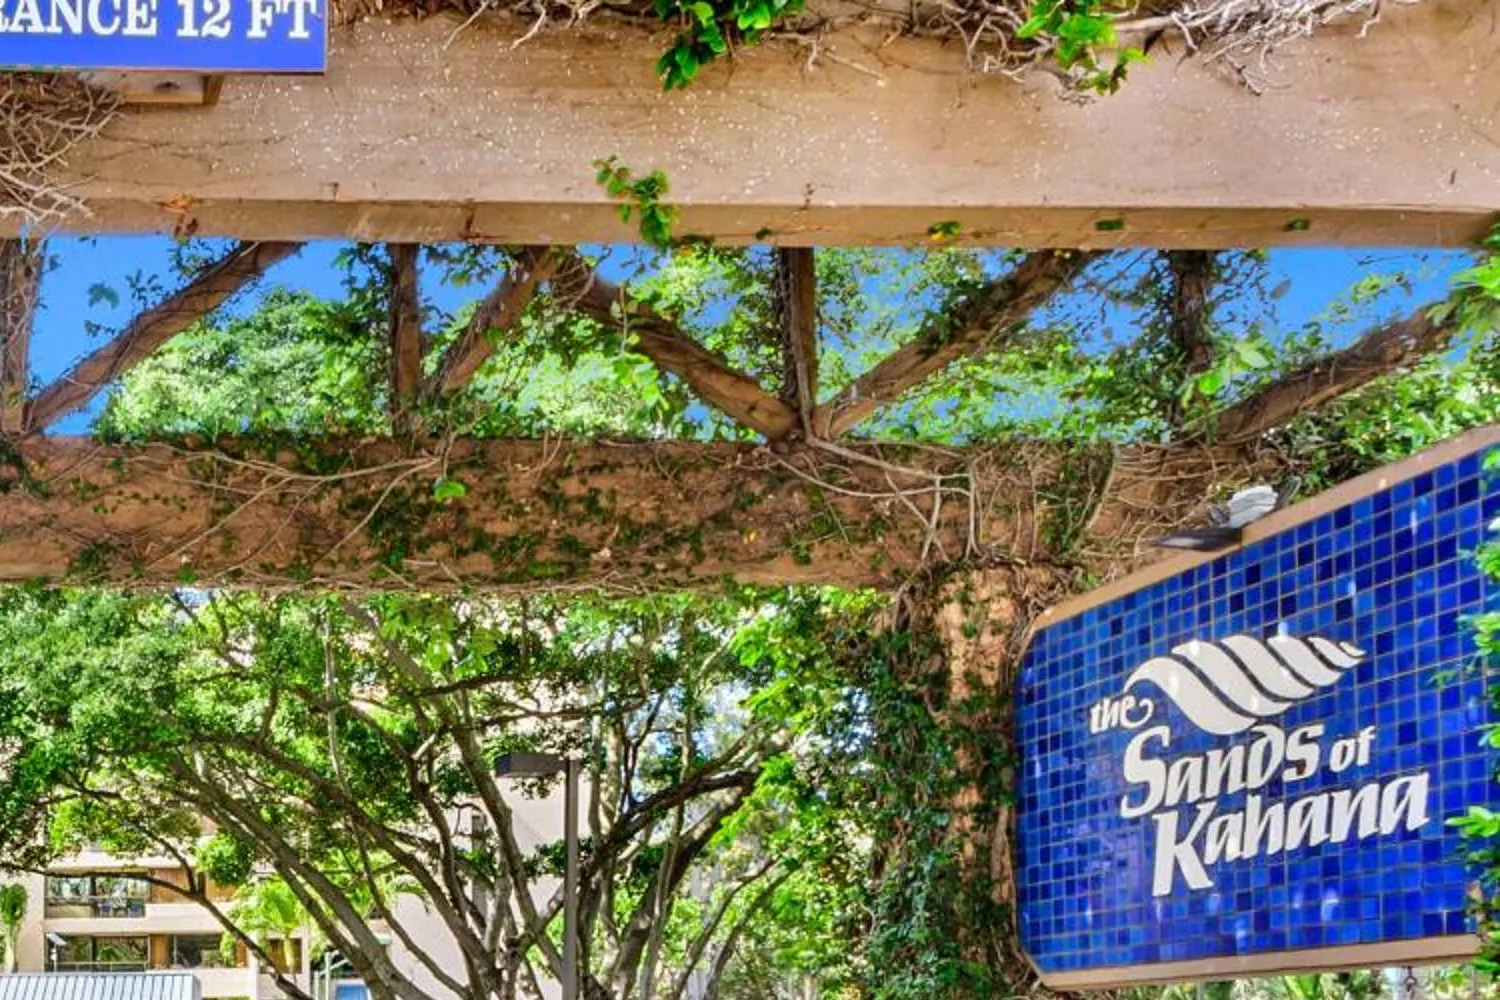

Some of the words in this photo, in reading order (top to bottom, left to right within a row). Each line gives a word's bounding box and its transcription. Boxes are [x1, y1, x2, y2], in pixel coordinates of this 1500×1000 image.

[176, 0, 232, 39] 12
[246, 0, 317, 39] FT
[1089, 695, 1154, 734] the
[1121, 724, 1325, 818] Sands
[1330, 726, 1376, 772] of
[1150, 771, 1431, 897] Kahana
